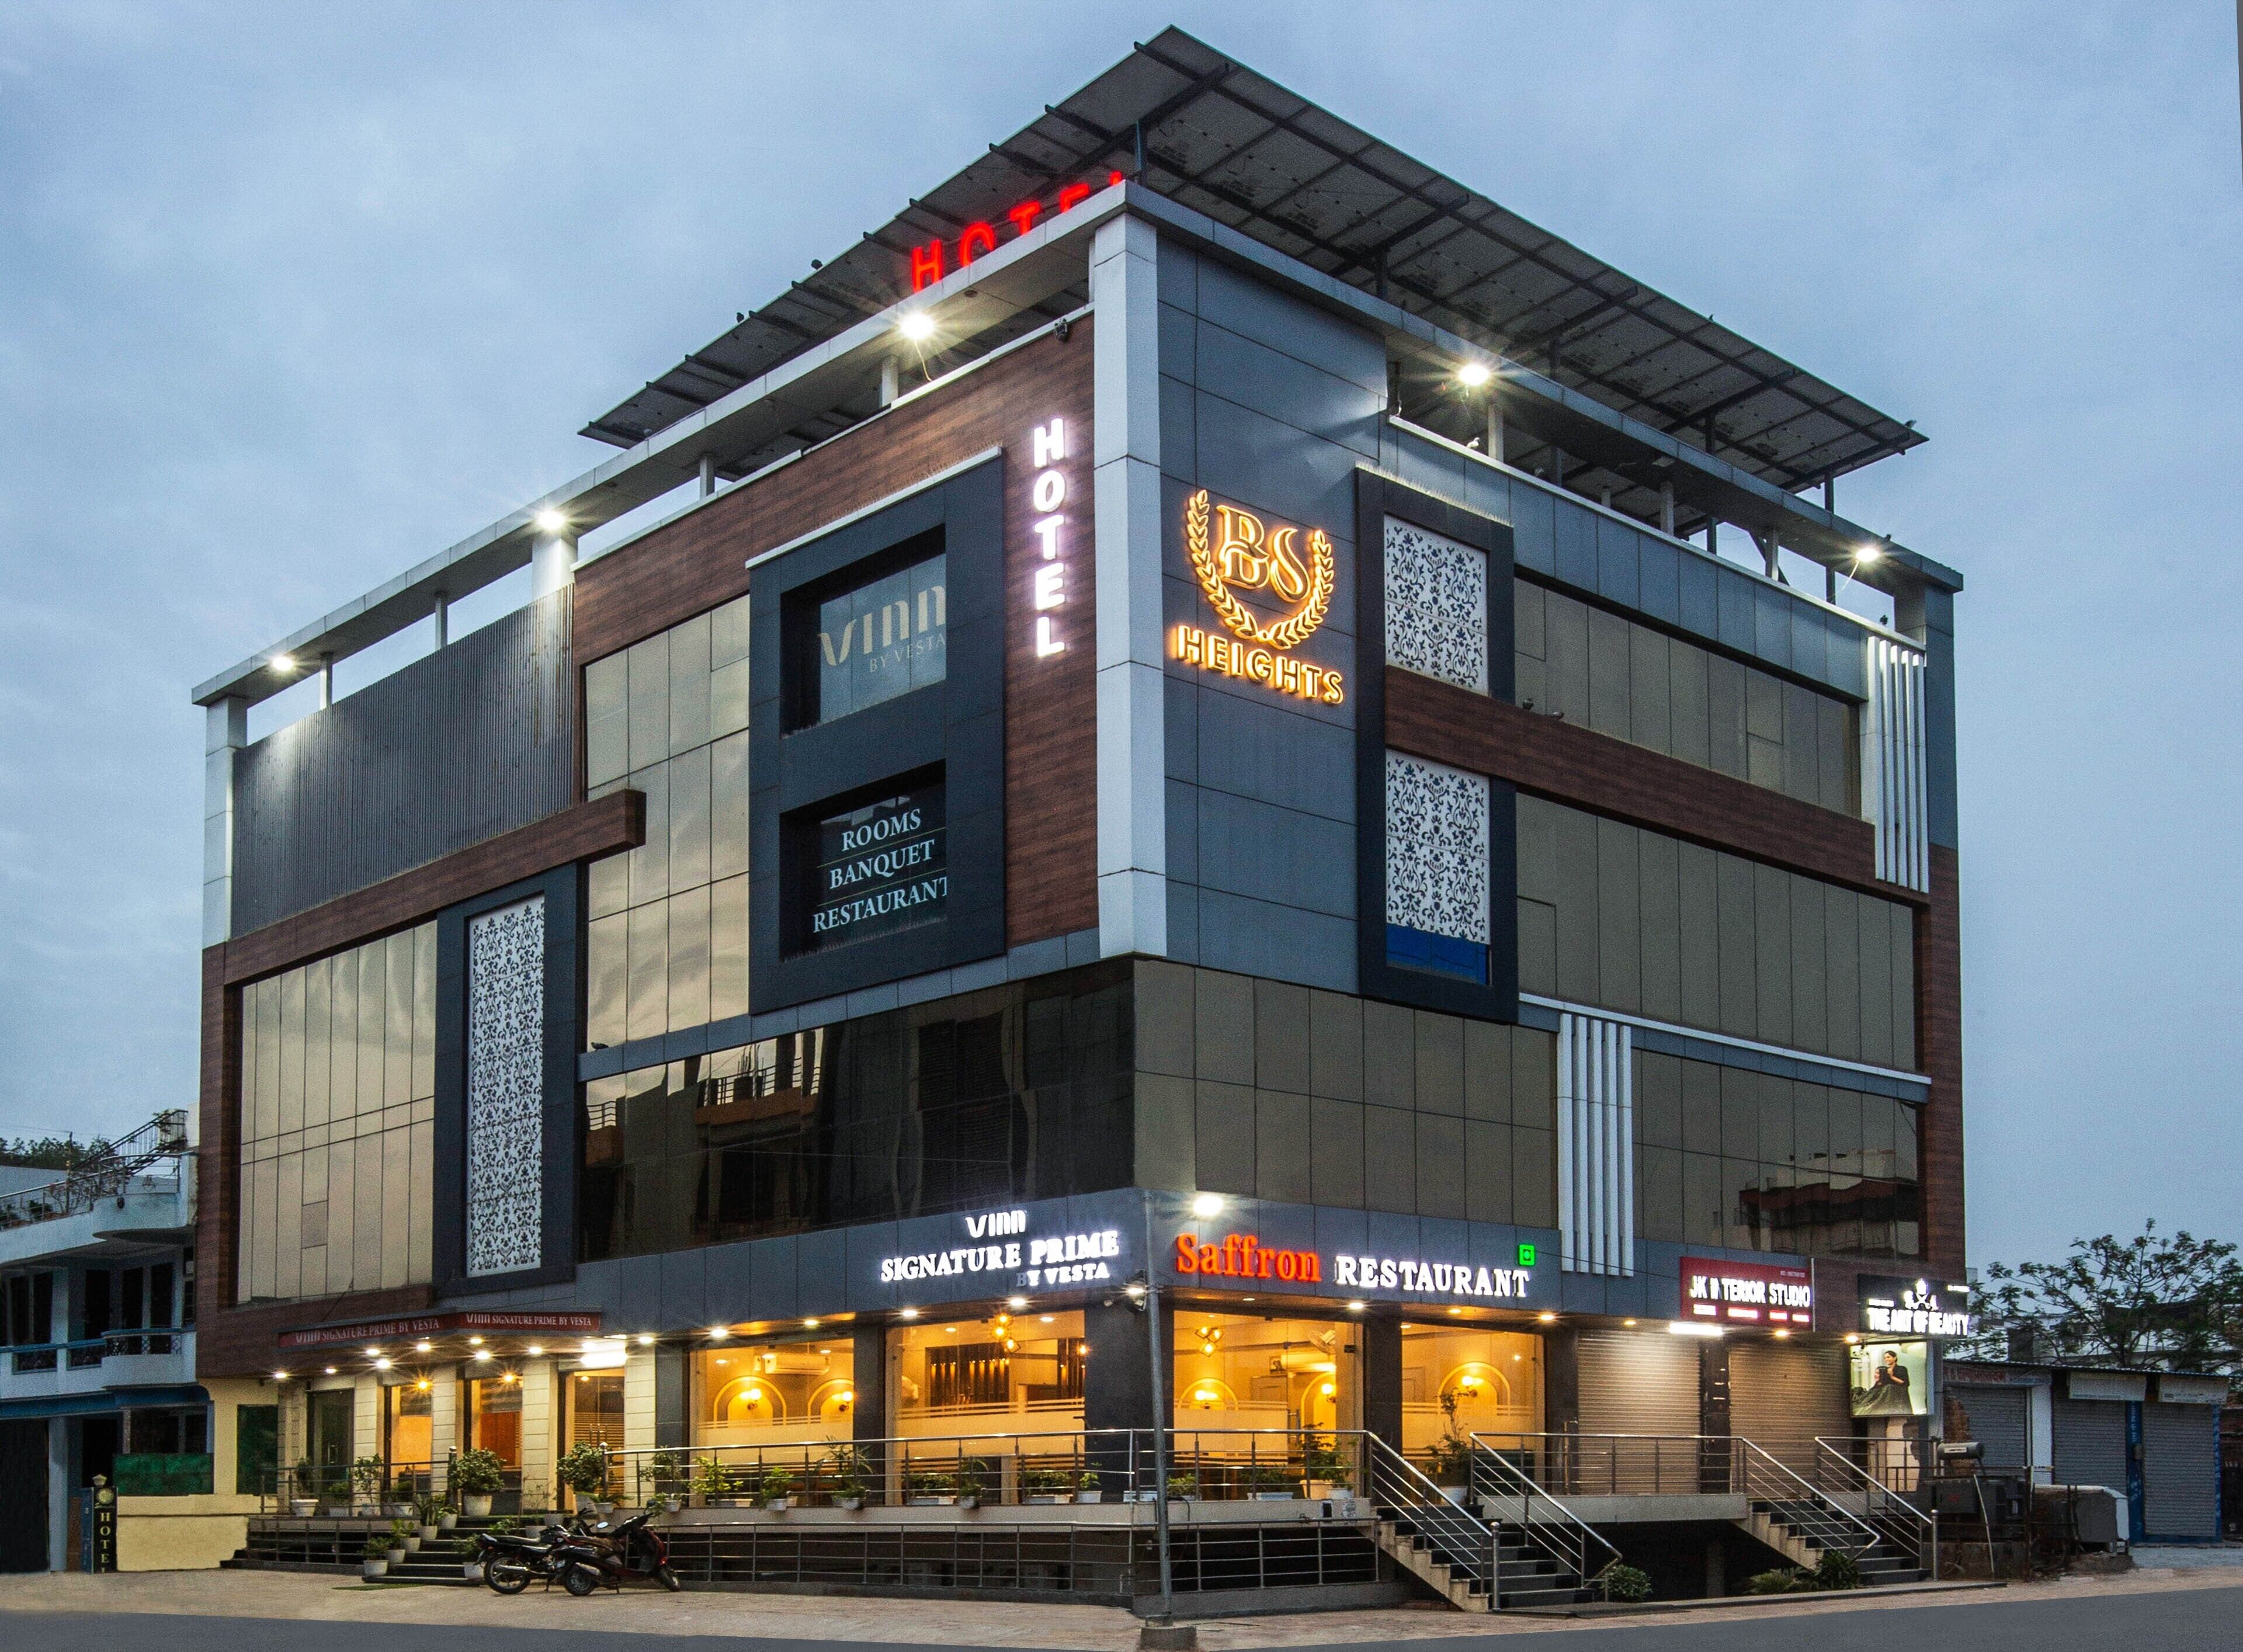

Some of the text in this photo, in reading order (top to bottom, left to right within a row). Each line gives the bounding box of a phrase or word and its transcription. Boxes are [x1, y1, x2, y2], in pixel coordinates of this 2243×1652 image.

[1033, 418, 1065, 657] HOTEL
[1217, 505, 1310, 602] BS
[870, 634, 946, 672] BY VESTA
[1176, 625, 1343, 704] HEIGHTS
[842, 808, 921, 852] ROOMS
[829, 839, 935, 890] BANQUET
[813, 877, 947, 933] RESTAURANT
[880, 1230, 1120, 1282] SIGNATURE PRIME
[1016, 1262, 1110, 1287] BY VESTA
[1176, 1233, 1530, 1298] Saffron RESTAURANT
[1689, 1275, 1709, 1299] JK
[1769, 1282, 1811, 1308] STUDIO
[322, 1327, 367, 1341] SIGNATURE
[369, 1321, 396, 1336] PRIME
[398, 1321, 409, 1332] BY
[412, 1318, 439, 1331] VESTA
[491, 1315, 533, 1325] SIGNATURE
[534, 1316, 557, 1325] PRIME
[558, 1316, 568, 1326] BY
[570, 1317, 592, 1326] VESTA
[1866, 1307, 1970, 1336] THE ART OF BEAUTY
